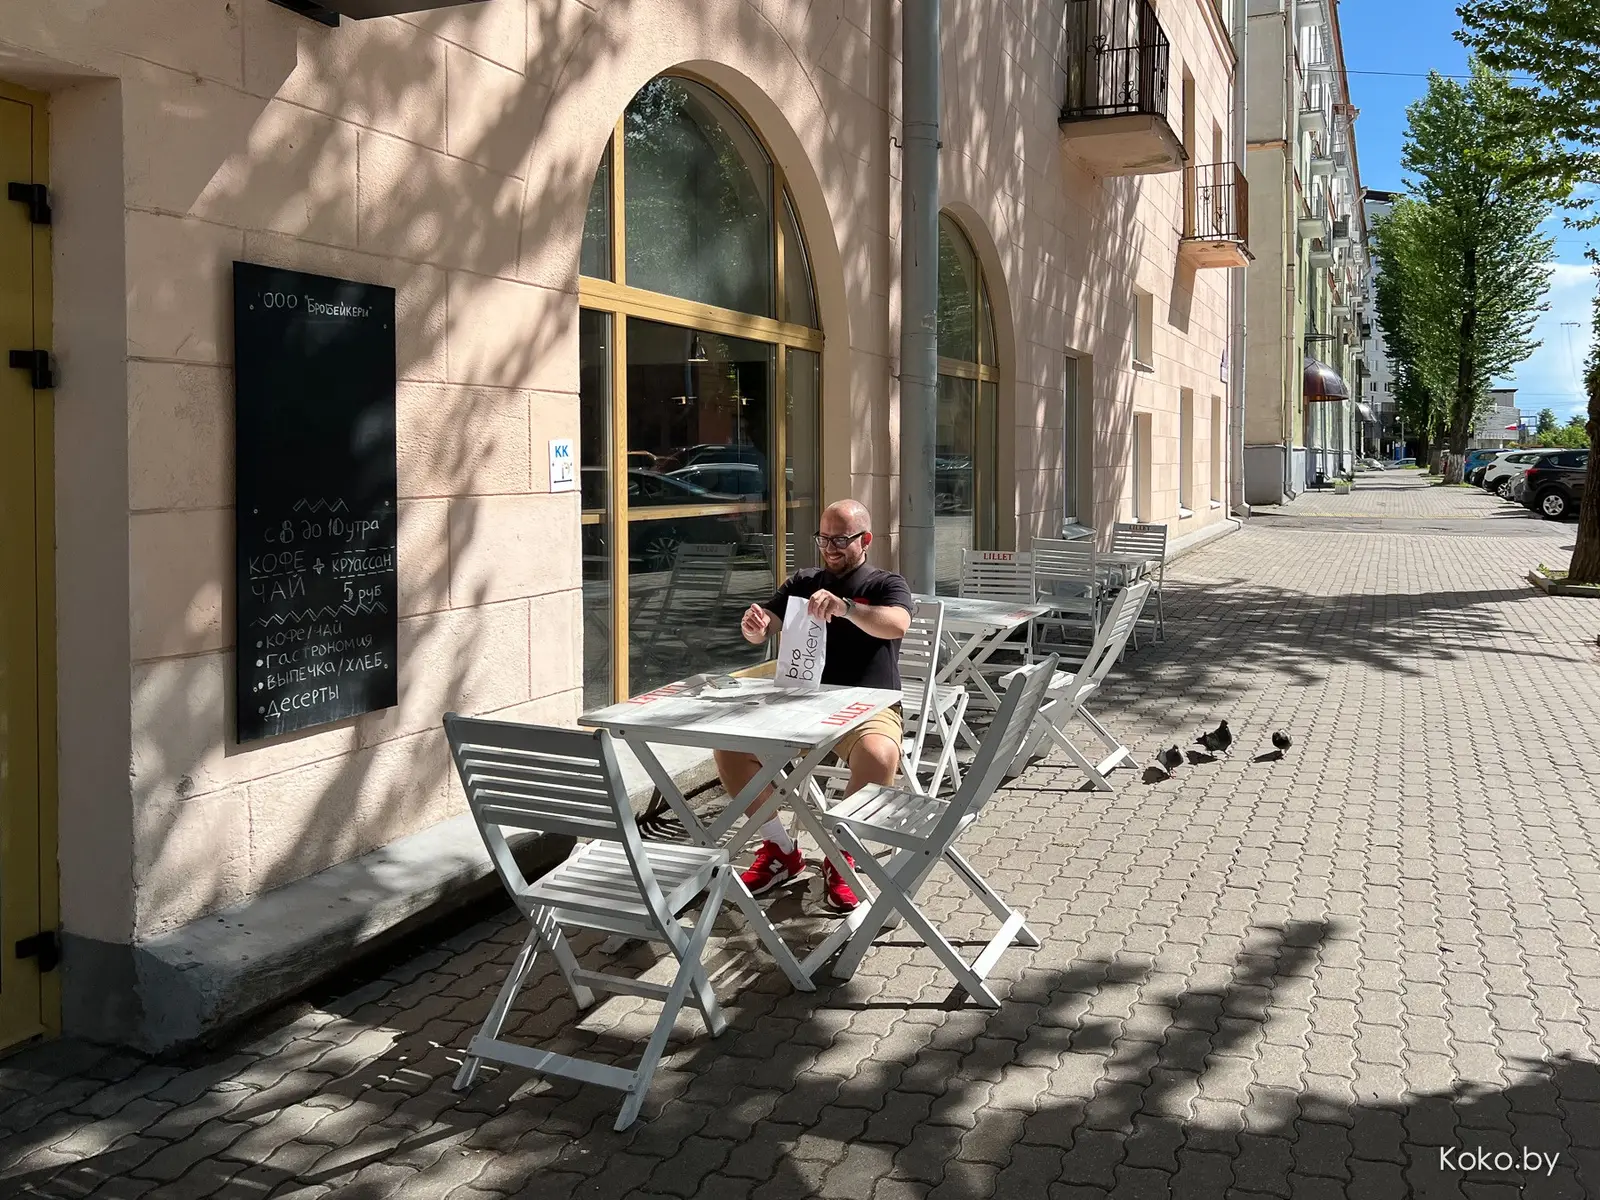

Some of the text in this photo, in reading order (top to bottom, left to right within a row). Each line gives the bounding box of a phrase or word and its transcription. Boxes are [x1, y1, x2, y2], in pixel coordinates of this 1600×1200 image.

[263, 292, 298, 309] ООО
[279, 520, 294, 544] 8
[249, 551, 305, 575] КОФЕ
[983, 552, 1014, 561] LILLET
[251, 574, 306, 604] ЧАЙ
[343, 581, 354, 603] 5
[799, 620, 822, 681] bakery
[820, 701, 876, 726] LILLET
